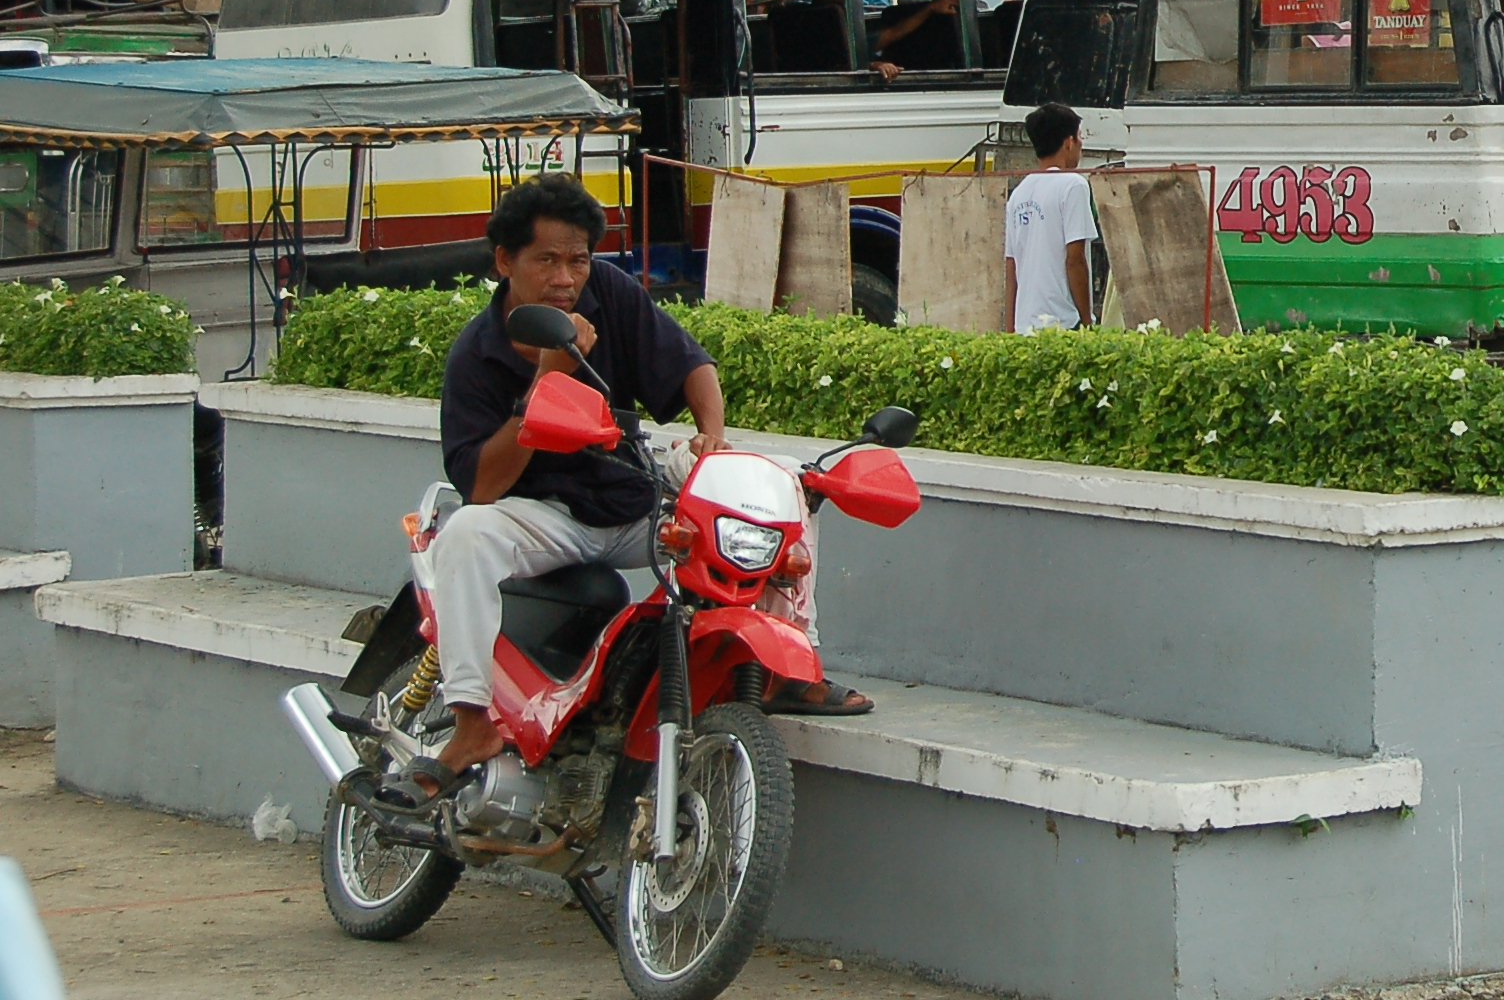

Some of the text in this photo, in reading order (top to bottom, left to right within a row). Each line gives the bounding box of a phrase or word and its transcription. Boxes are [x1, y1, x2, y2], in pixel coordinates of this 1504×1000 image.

[1373, 15, 1427, 29] TANDUAY
[1216, 165, 1374, 245] 4953
[741, 502, 776, 517] HONDA
